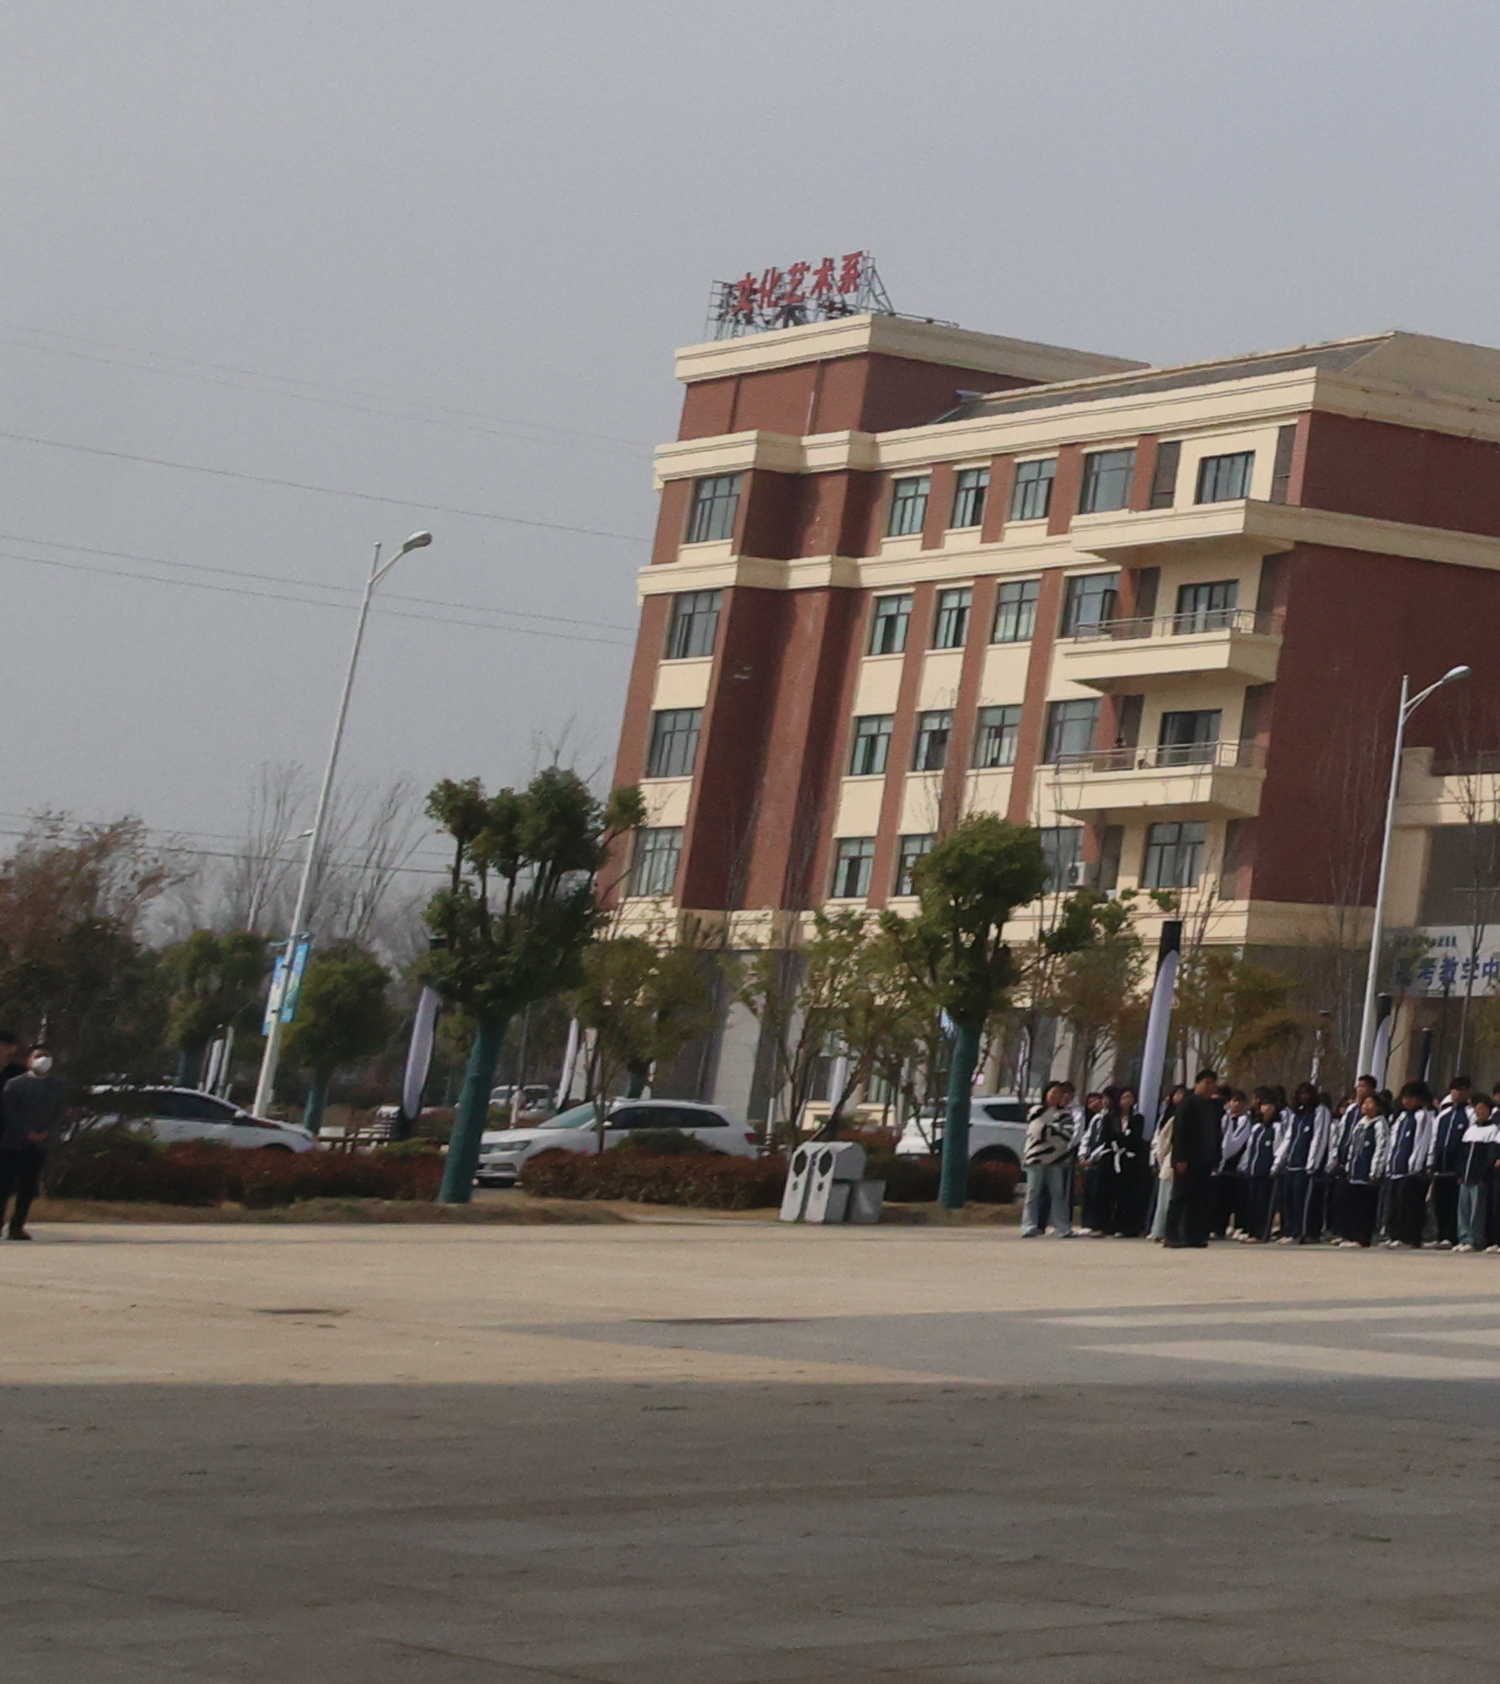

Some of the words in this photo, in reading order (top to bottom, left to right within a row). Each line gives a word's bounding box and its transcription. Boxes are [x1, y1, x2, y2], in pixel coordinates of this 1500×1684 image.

[731, 250, 863, 314] 文化艺术系
